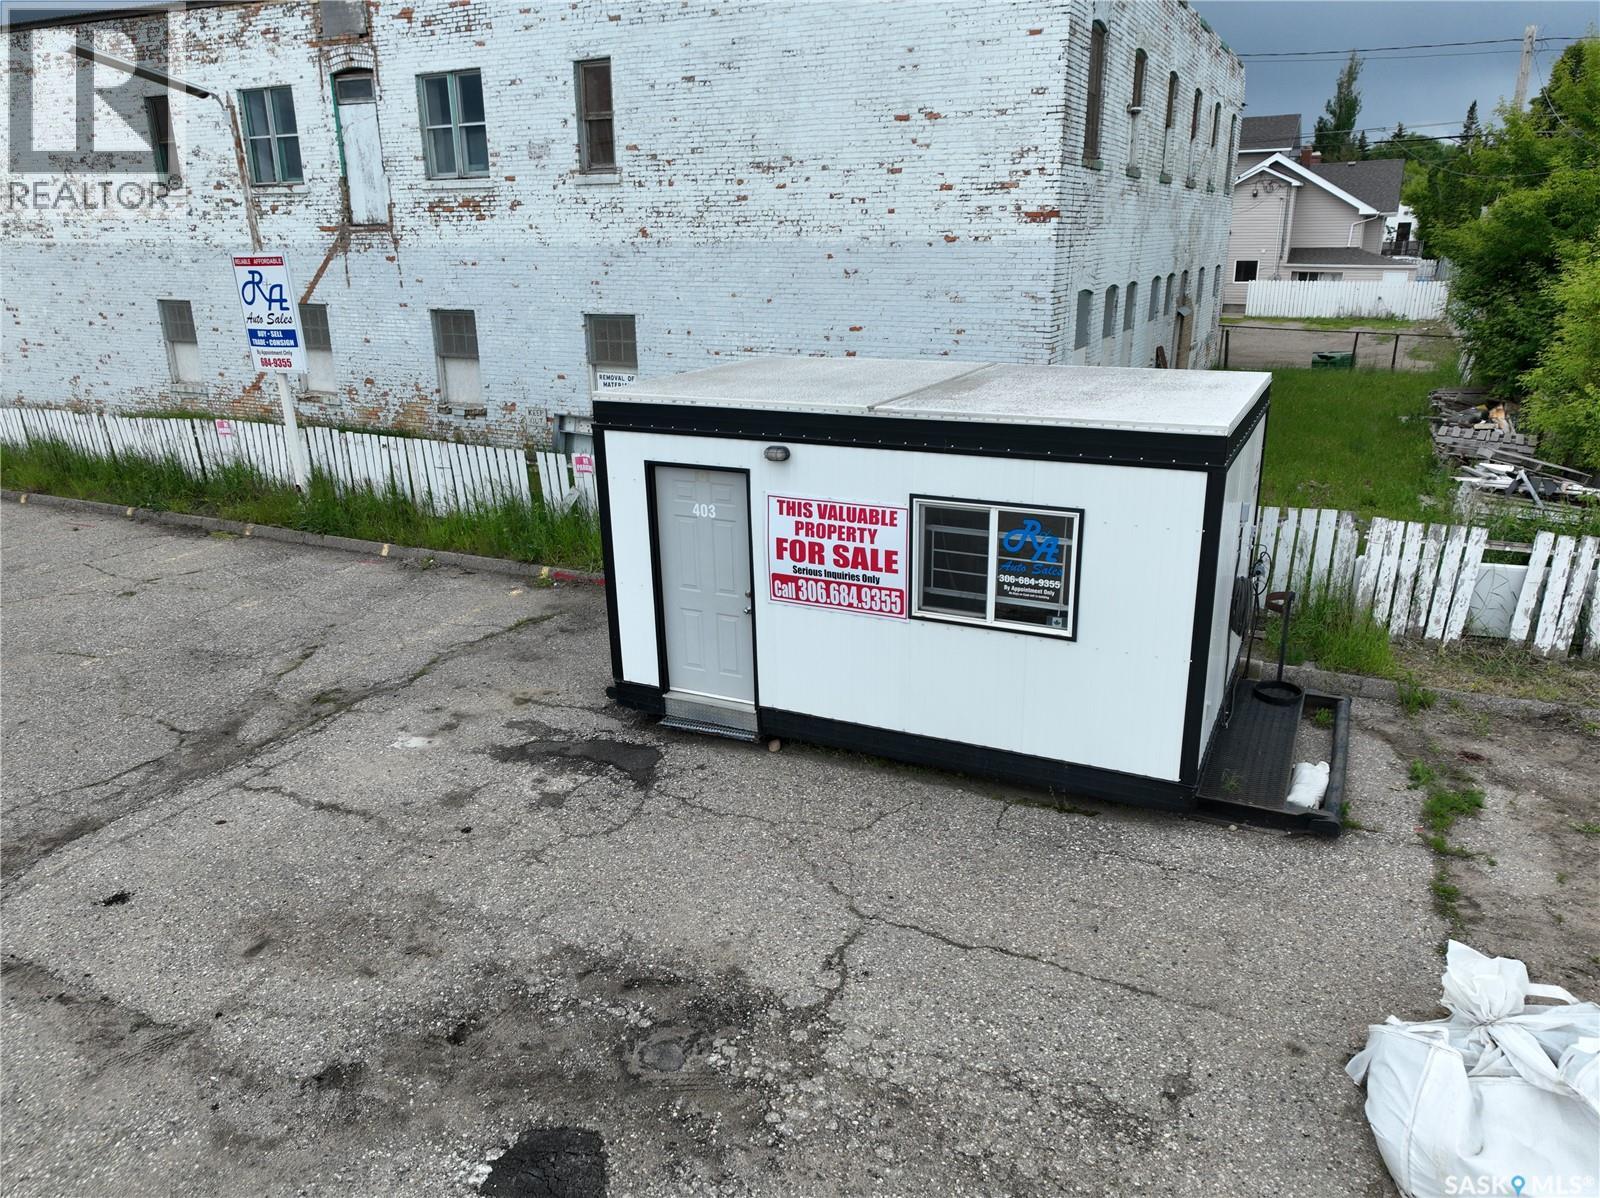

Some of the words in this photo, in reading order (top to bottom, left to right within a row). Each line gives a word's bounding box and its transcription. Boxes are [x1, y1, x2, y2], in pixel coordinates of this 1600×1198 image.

[246, 311, 264, 324] Auto
[266, 312, 293, 325] Sales
[257, 330, 267, 338] BUY
[270, 330, 283, 338] SELL
[252, 338, 267, 346] TRADE
[269, 338, 295, 346] CONSIGN
[260, 357, 292, 368] 684-9355
[599, 374, 625, 382] REMOVAL
[692, 503, 716, 518] 403
[776, 499, 813, 519] THIS
[817, 503, 898, 527] VALUABLE
[794, 520, 878, 545] PROPERTY
[776, 537, 826, 566] FOR
[832, 544, 899, 574] SALE
[792, 565, 822, 577] Serious
[824, 568, 860, 582] Inquiries
[862, 574, 880, 586] Only
[1000, 560, 1027, 573] Auto
[1032, 563, 1063, 576] Sales
[999, 574, 1061, 590] 306-684-9355
[774, 580, 796, 599] Call
[798, 579, 901, 613] 306.684.9355
[1011, 586, 1042, 594] Appointment
[1043, 589, 1056, 597] Only
